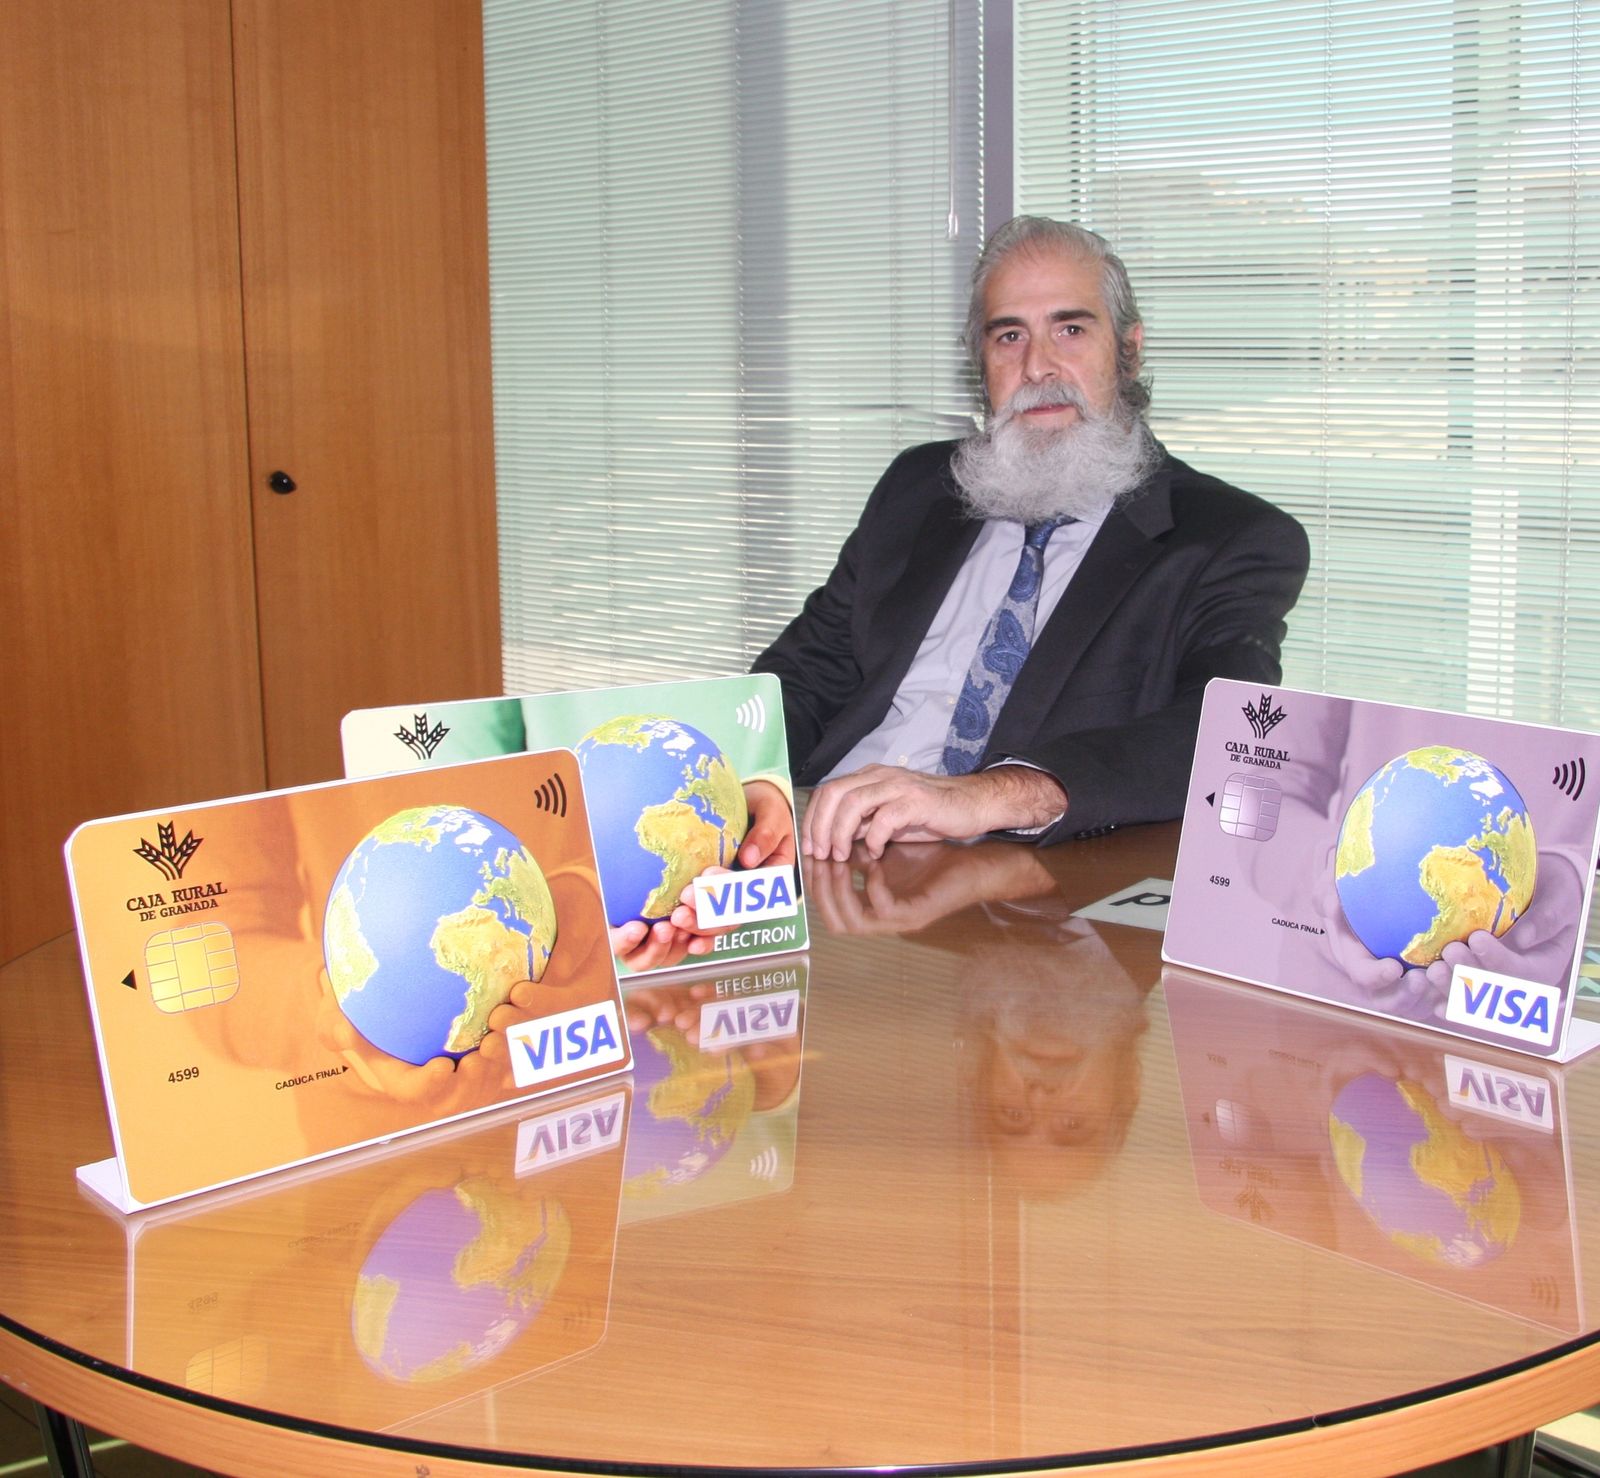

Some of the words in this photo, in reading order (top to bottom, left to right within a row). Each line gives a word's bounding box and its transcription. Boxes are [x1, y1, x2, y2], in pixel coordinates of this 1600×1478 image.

[1225, 741, 1249, 755] CAJA
[1254, 746, 1290, 761] RURAL
[1230, 753, 1241, 762] DE
[1243, 756, 1281, 770] GRANADA
[1209, 875, 1230, 887] 4599
[126, 893, 167, 911] CAJA
[171, 882, 228, 903] RURAL
[699, 876, 792, 916] VISA
[139, 911, 156, 922] DE
[160, 899, 219, 917] GRANADA
[1271, 917, 1299, 930] CADUCA
[1300, 924, 1319, 935] FINAL
[714, 926, 796, 952] ELECTRON
[1457, 976, 1548, 1034] VISA
[512, 1014, 617, 1071] VISA
[167, 1066, 200, 1084] 4599
[275, 1074, 315, 1091] CADUCA
[315, 1067, 342, 1081] FINAL
